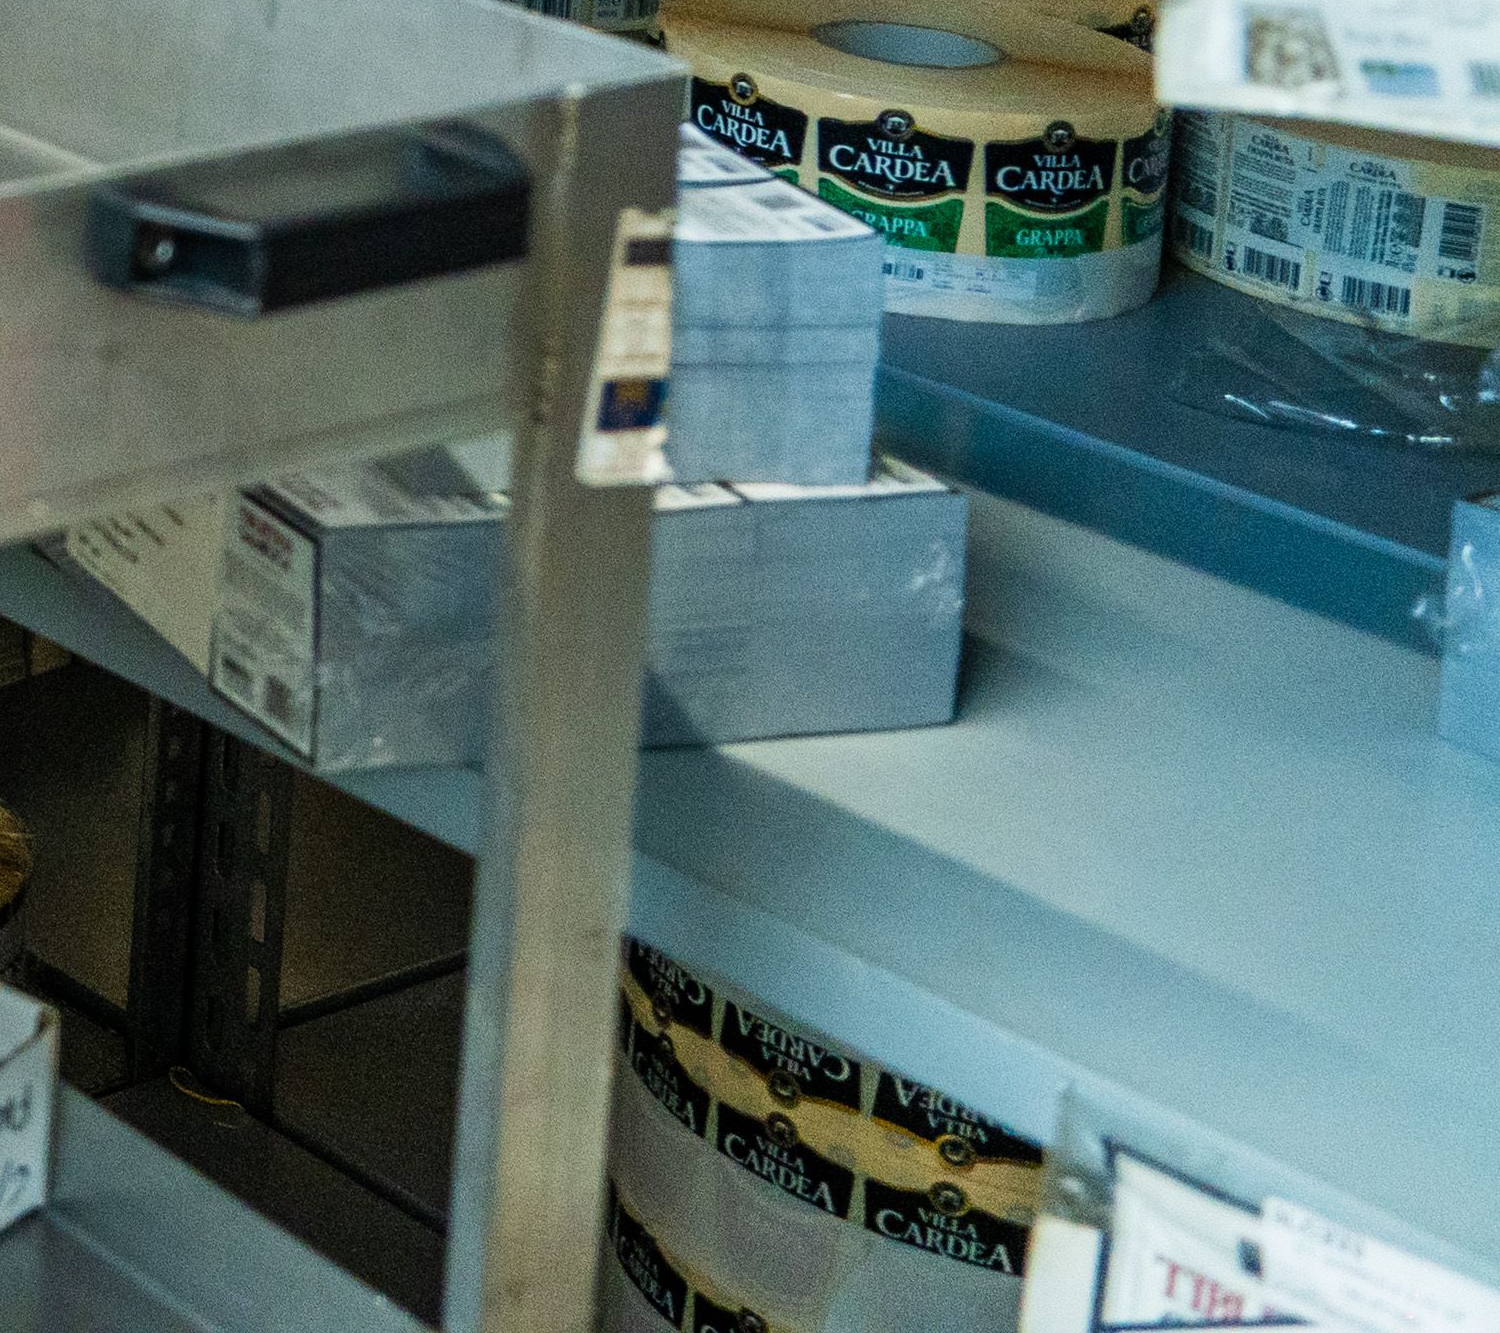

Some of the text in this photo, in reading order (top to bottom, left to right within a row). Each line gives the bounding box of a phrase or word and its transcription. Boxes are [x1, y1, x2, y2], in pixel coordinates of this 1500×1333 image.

[721, 99, 764, 127] VILLA
[697, 104, 793, 159] CARDEA
[867, 136, 924, 160] VILLA
[829, 144, 956, 188] CARDEA
[1033, 154, 1081, 169] VILLA
[996, 167, 1104, 194] CARDEA
[1015, 229, 1084, 247] GRAPPA
[754, 1135, 805, 1174] VILLA
[723, 1133, 835, 1215] CARDEA
[917, 1206, 978, 1239] VILLA
[875, 1208, 1013, 1274] CARDEA
